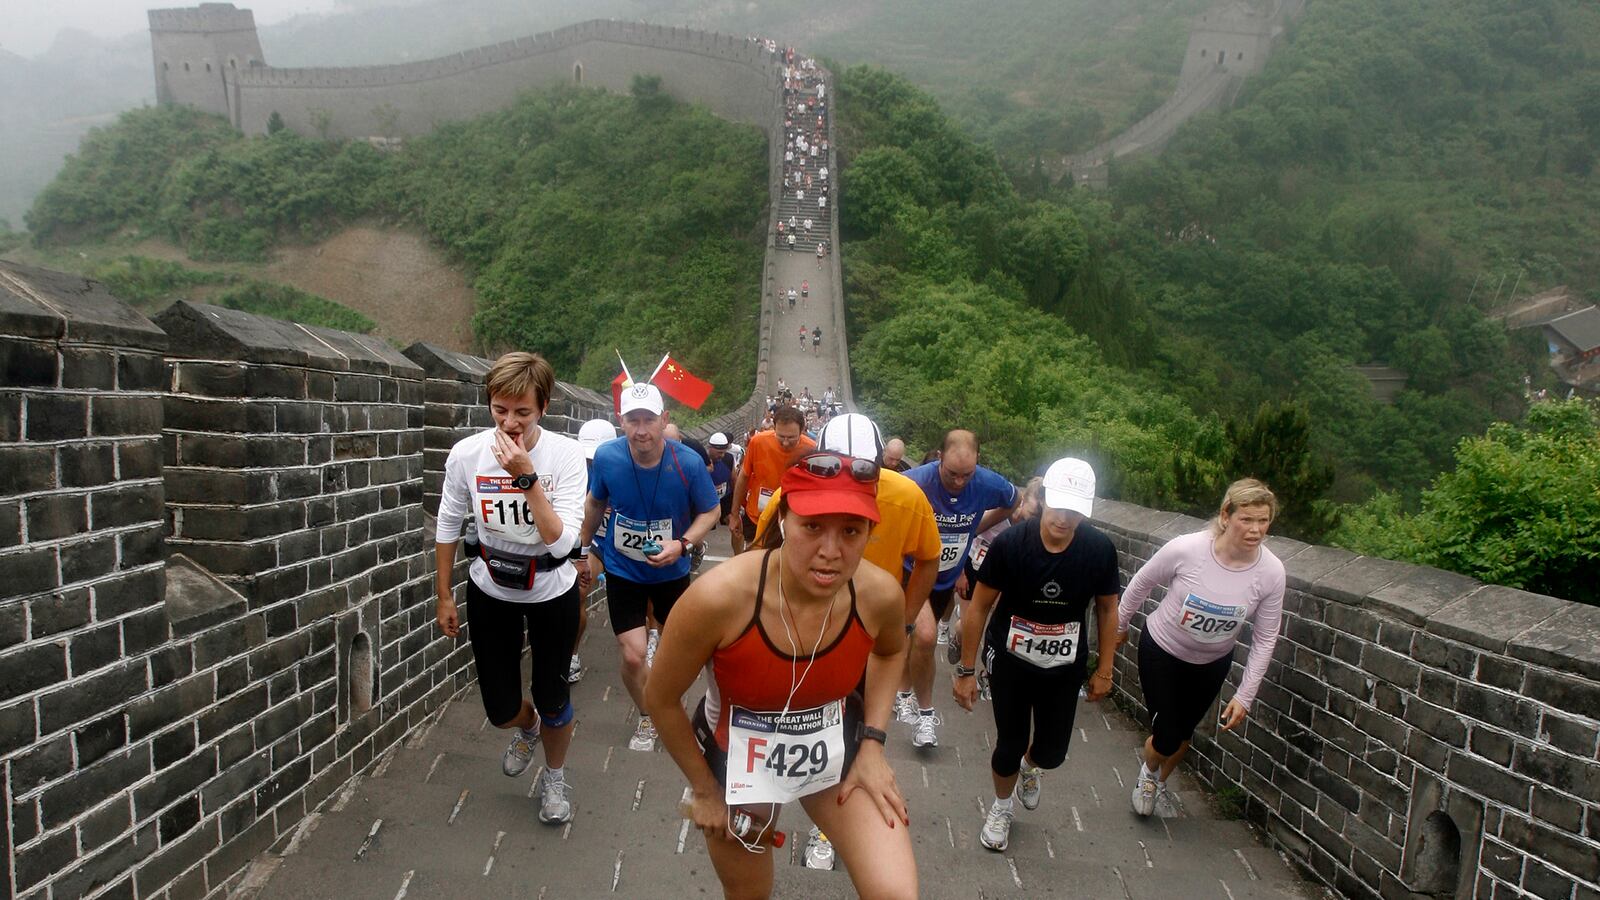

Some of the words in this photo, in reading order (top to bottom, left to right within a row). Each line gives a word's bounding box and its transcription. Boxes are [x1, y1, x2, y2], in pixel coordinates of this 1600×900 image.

[481, 500, 535, 525] F116
[941, 547, 958, 561] 85
[1181, 610, 1237, 632] F2079
[1011, 633, 1072, 656] F1488
[757, 715, 772, 723] THE
[774, 714, 801, 724] GREAT
[802, 712, 822, 722] WALL
[780, 720, 821, 731] MARATHON
[747, 737, 829, 777] F429
